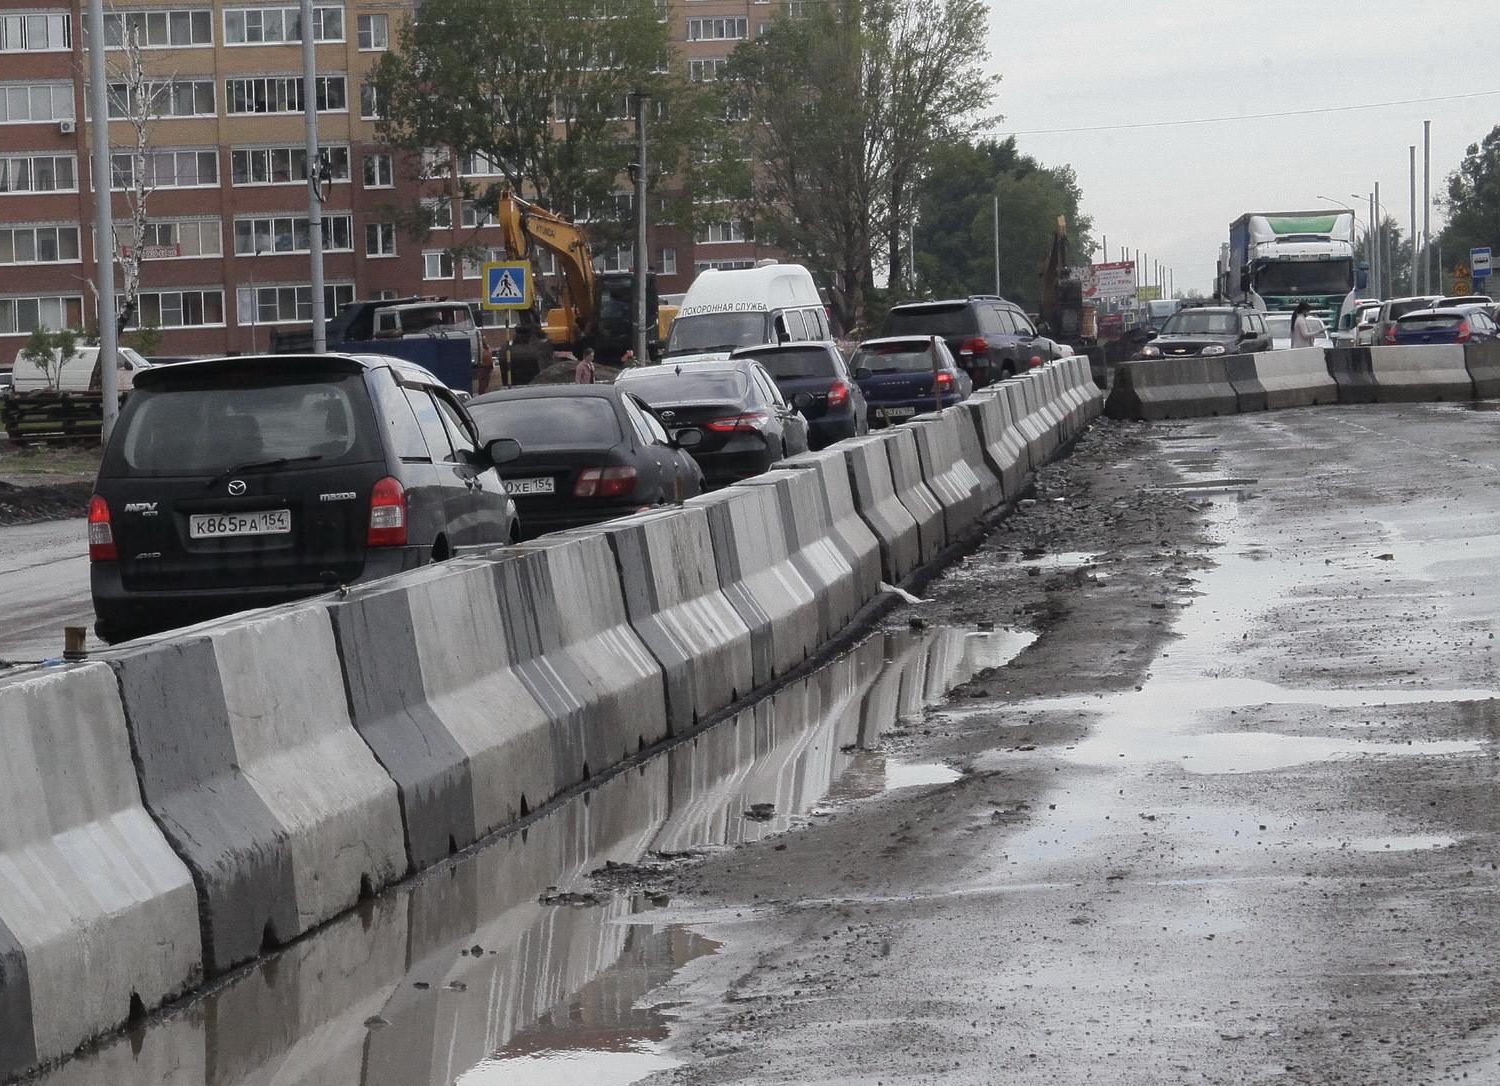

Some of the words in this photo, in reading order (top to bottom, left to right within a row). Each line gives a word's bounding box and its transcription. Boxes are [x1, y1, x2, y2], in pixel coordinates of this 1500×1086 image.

[683, 303, 733, 317] ПОХОРОННАЯ
[735, 303, 767, 311] СЛУЖБА
[533, 479, 553, 488] 154
[262, 514, 285, 526] 154
